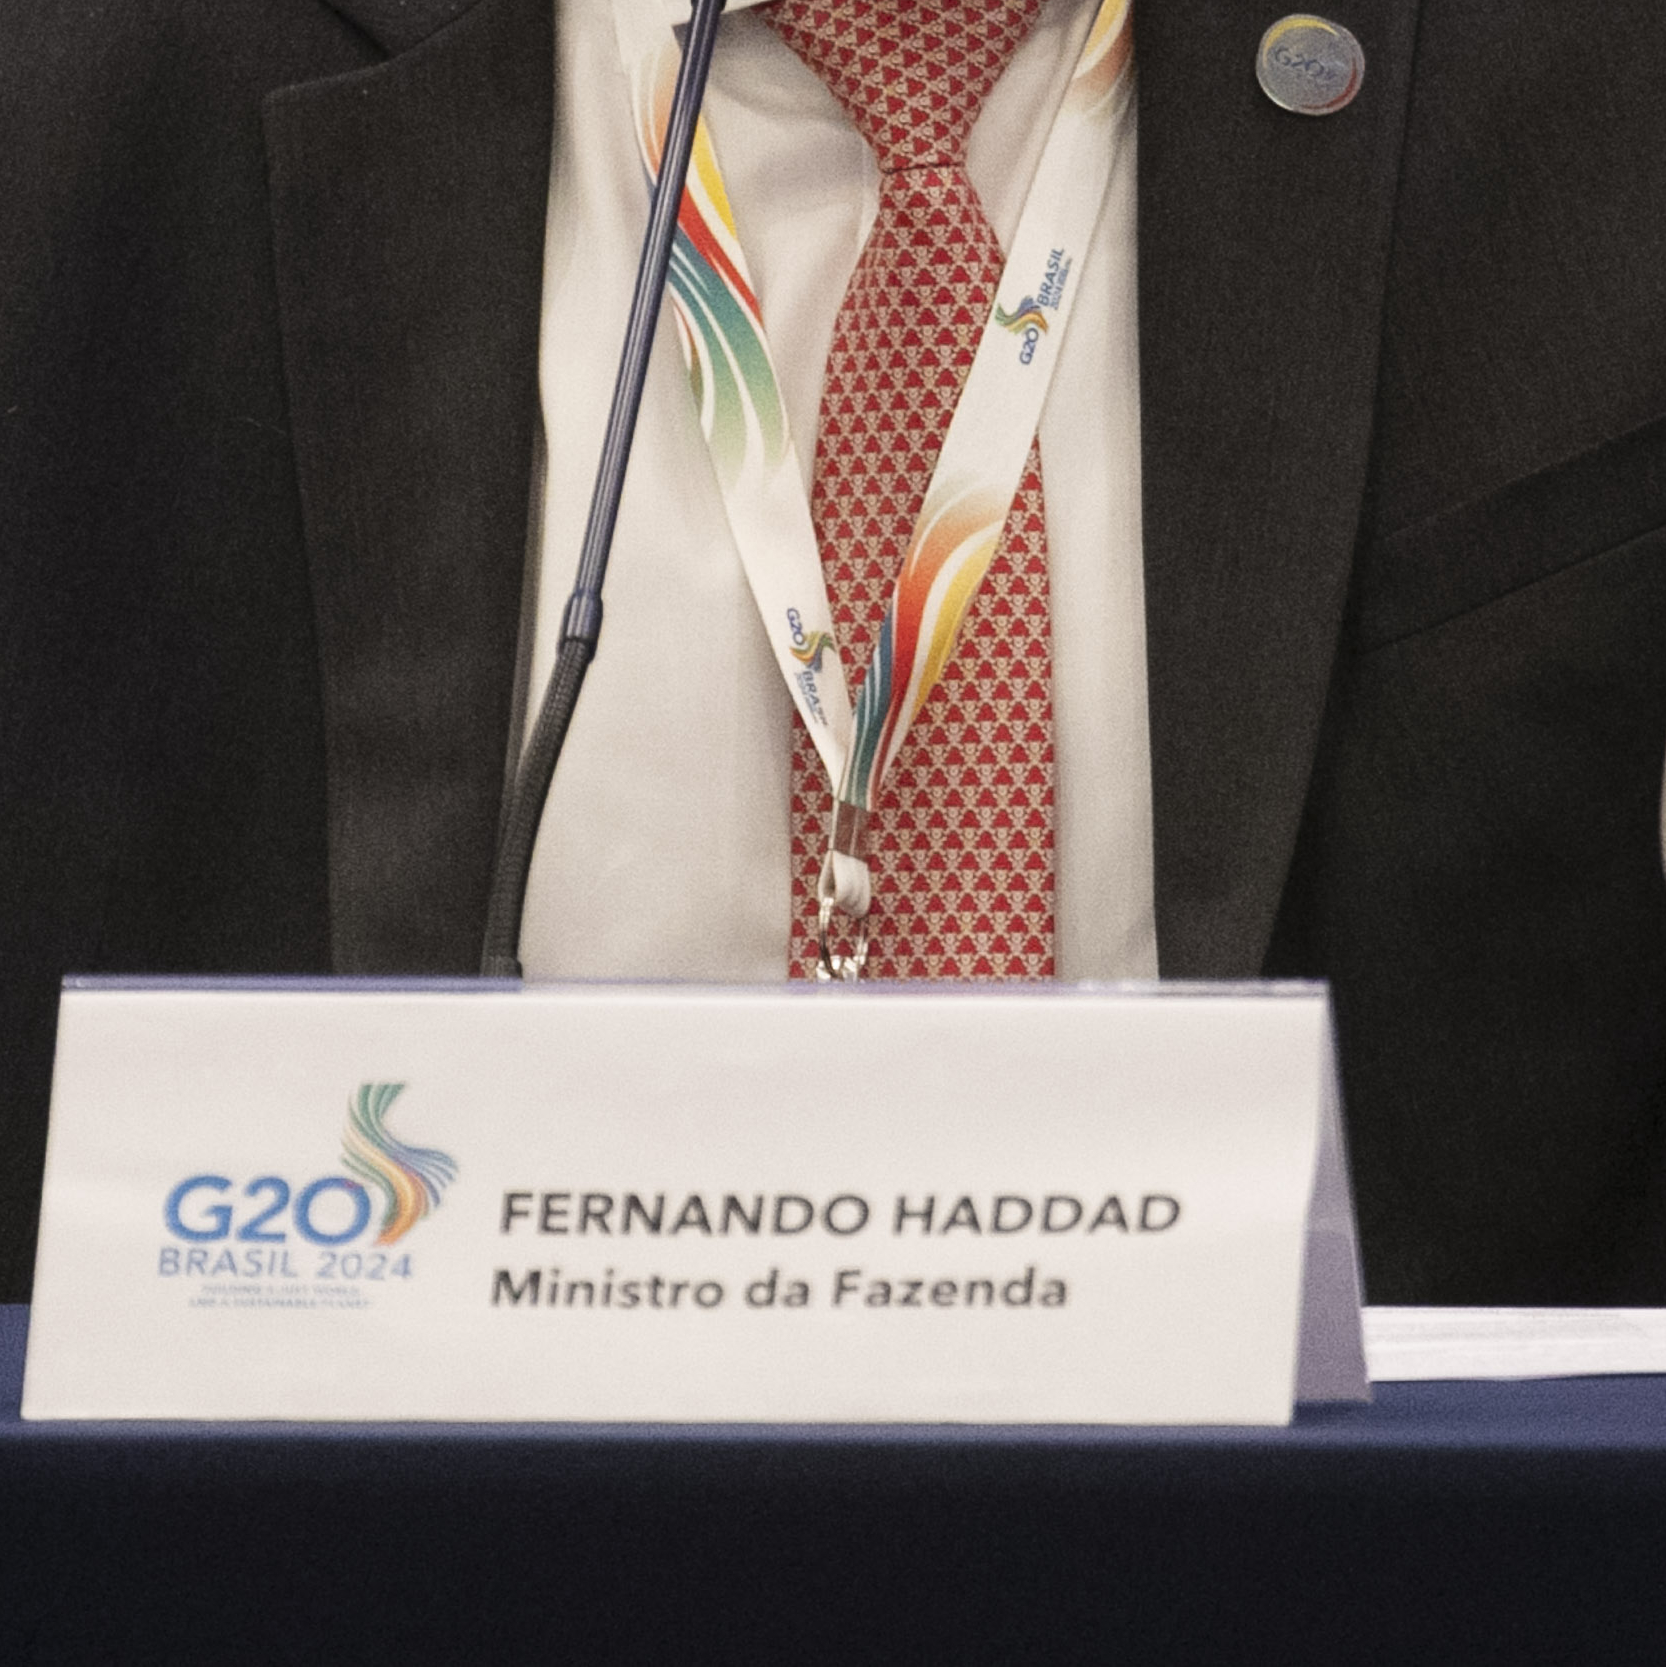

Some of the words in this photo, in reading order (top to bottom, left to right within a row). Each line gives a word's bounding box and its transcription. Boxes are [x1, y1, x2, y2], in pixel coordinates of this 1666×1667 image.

[1037, 247, 1064, 307] BRASIL
[1019, 327, 1040, 366] G20
[786, 607, 807, 646] G20
[163, 1175, 372, 1248] G20
[498, 1190, 871, 1236] FERNANDO
[892, 1193, 1181, 1236] HADDAD
[157, 1245, 298, 1279] BRASIL
[314, 1251, 413, 1281] 2024
[490, 1265, 725, 1309] Ministro
[744, 1265, 811, 1309] da
[831, 1264, 1068, 1309] Fazenda
